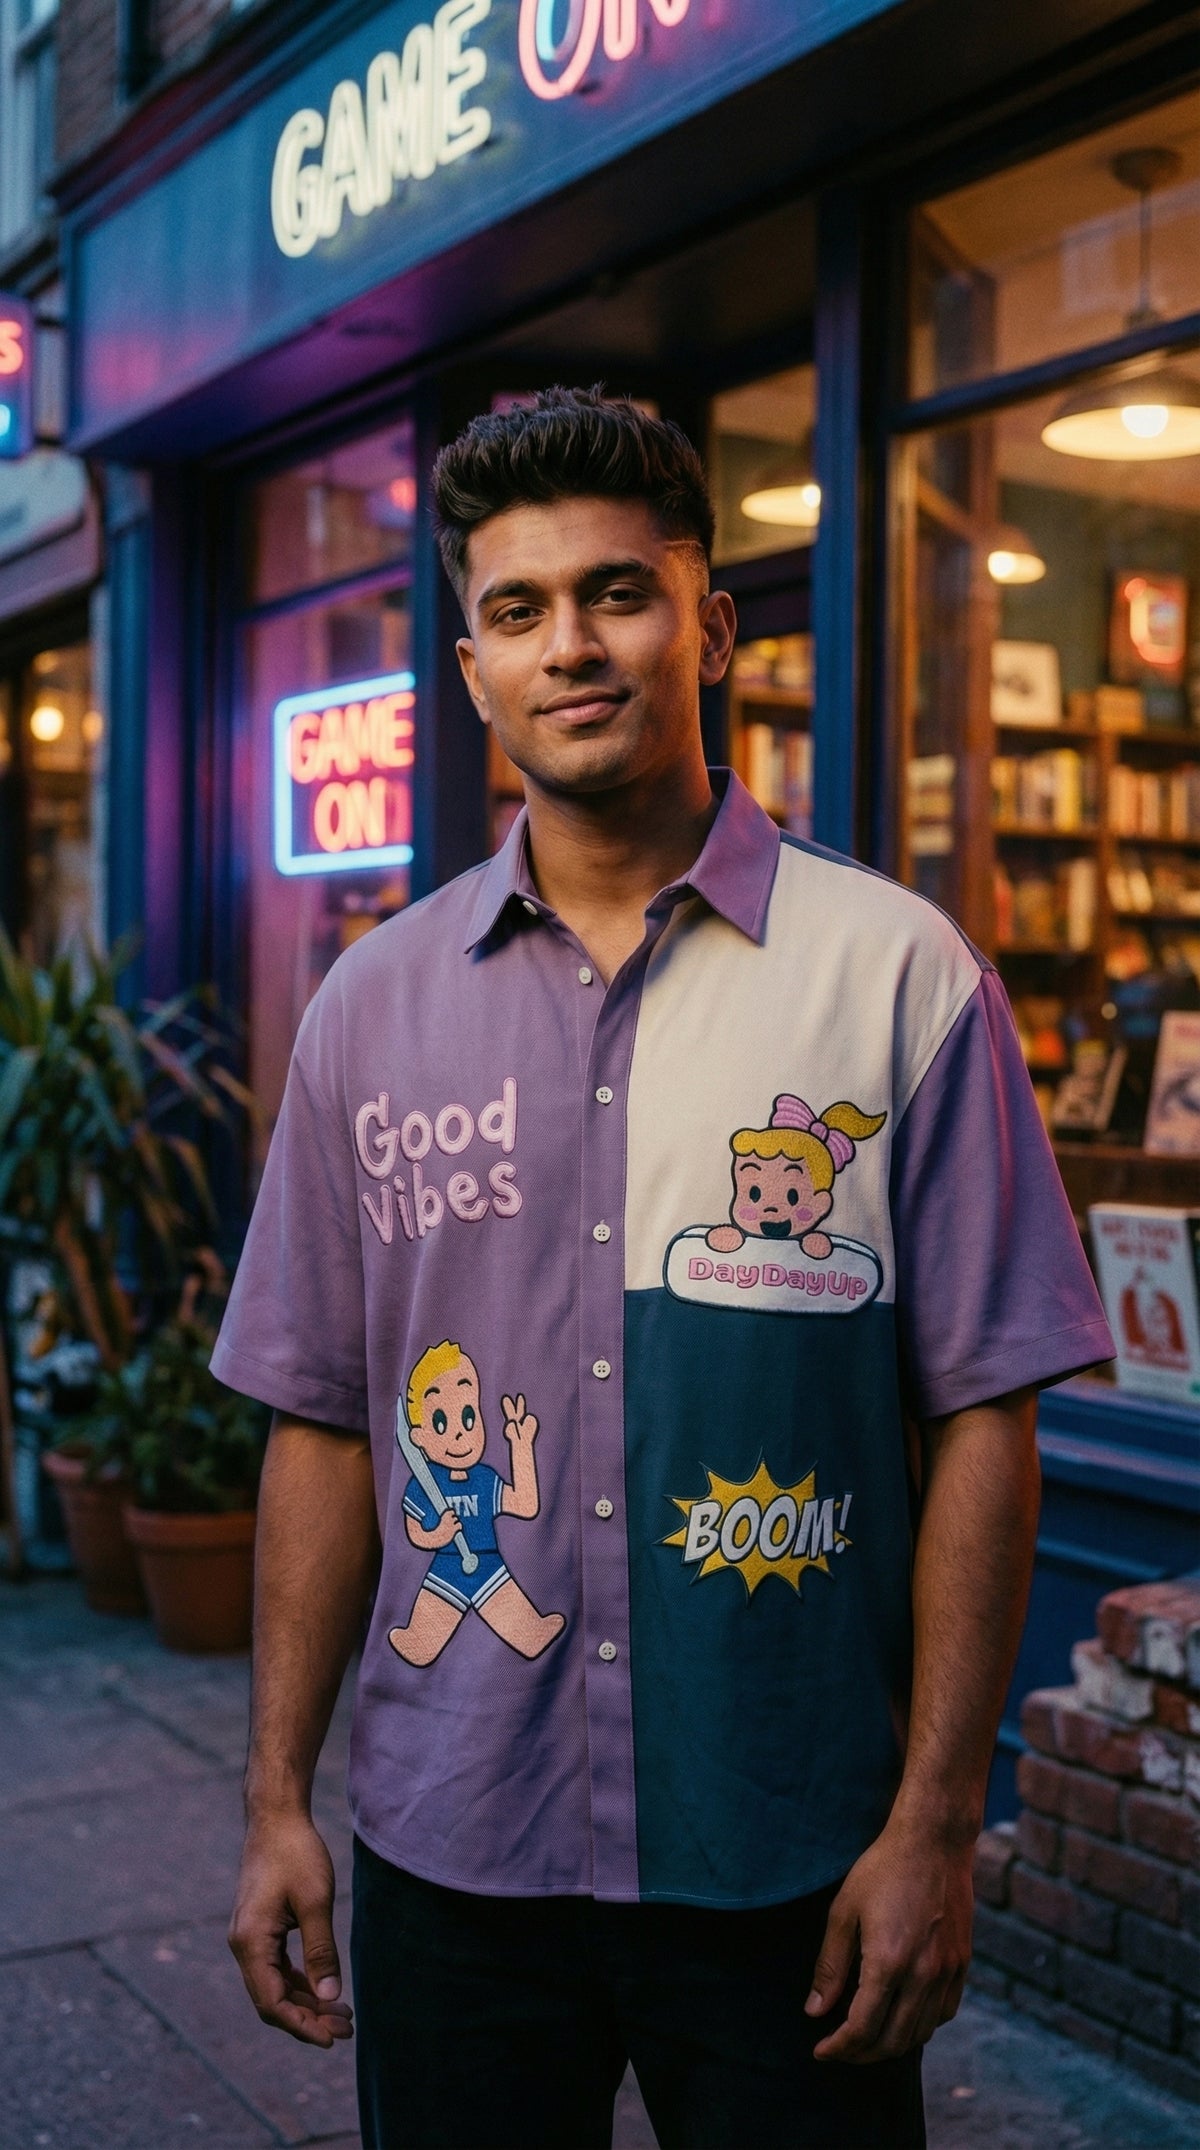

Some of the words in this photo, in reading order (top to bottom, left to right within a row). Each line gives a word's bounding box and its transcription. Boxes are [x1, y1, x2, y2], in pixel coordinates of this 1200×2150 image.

[271, 0, 491, 258] GAME
[288, 691, 416, 784] GAME
[314, 776, 387, 853] ON
[355, 1077, 518, 1180] Good
[684, 1494, 853, 1562] BOOM!
